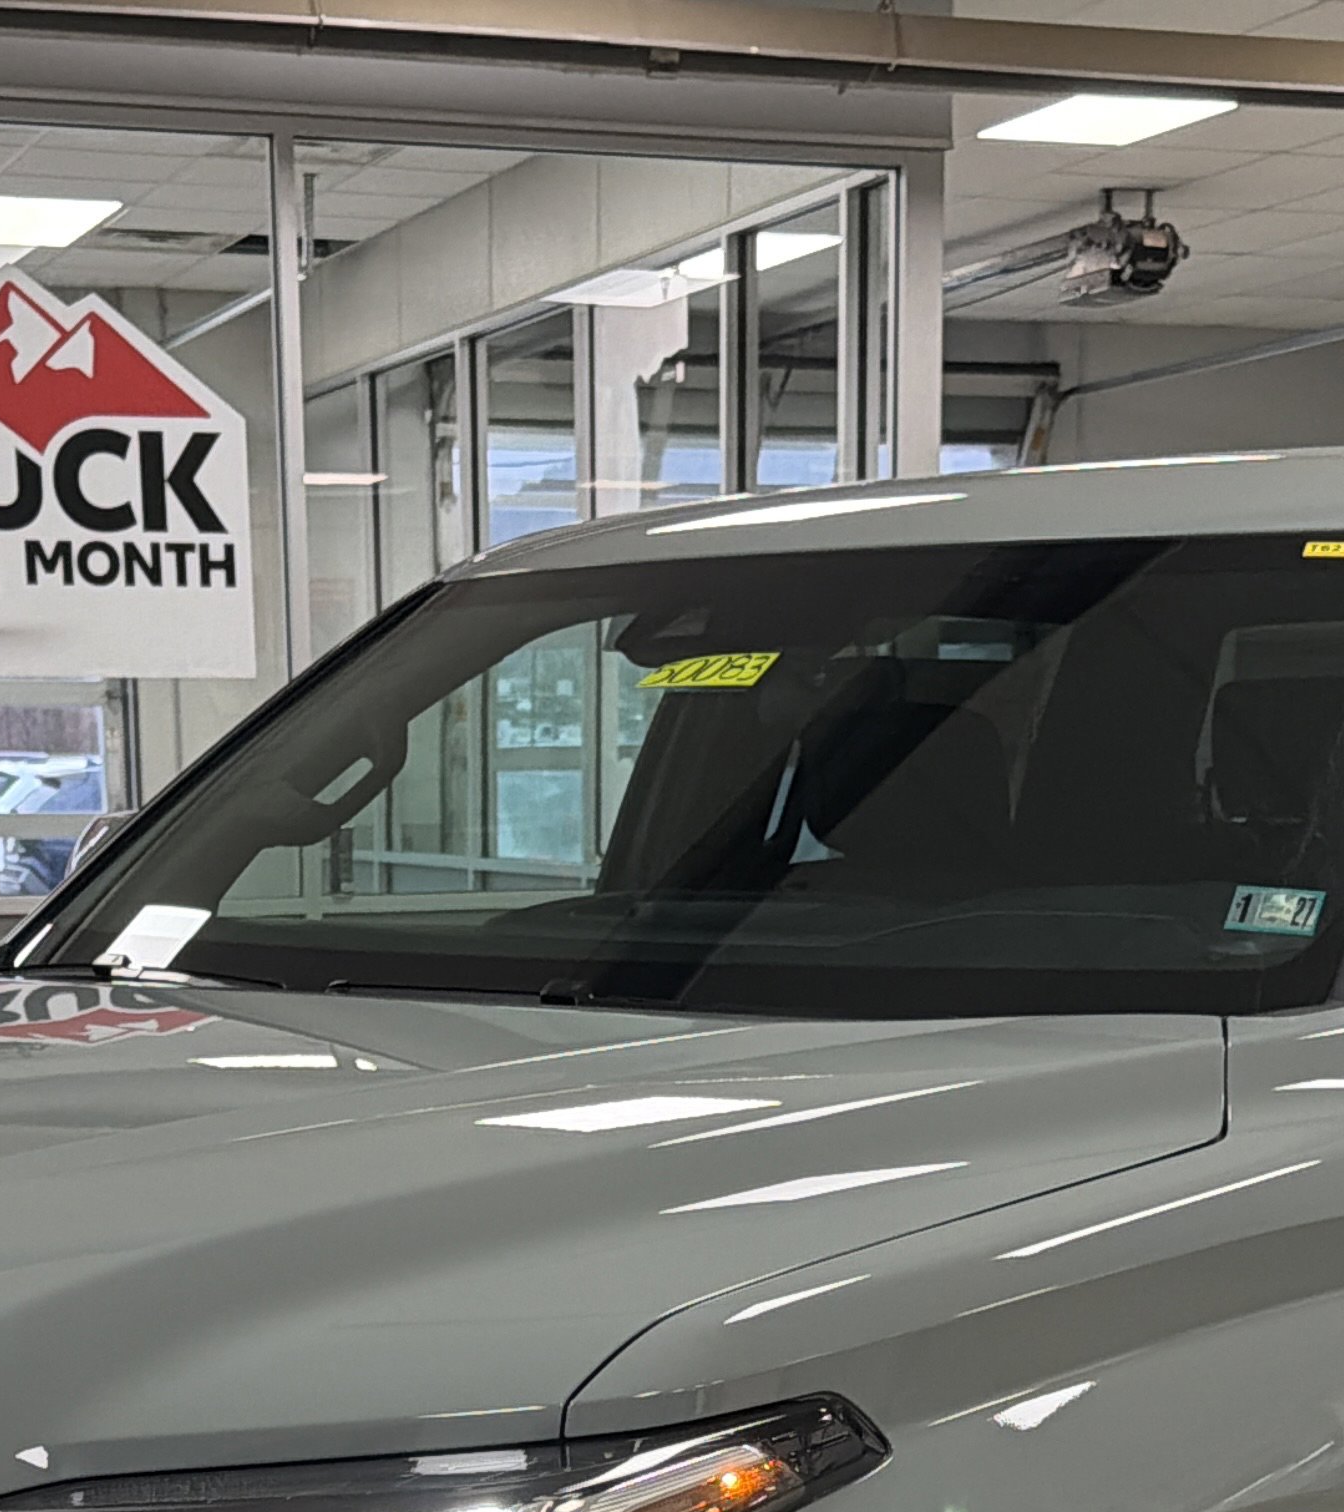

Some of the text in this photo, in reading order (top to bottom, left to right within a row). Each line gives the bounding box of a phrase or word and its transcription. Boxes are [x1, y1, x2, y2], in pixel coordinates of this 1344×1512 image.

[25, 539, 237, 588] MONTH
[639, 655, 771, 686] 50083
[1238, 893, 1318, 930] 1 27
